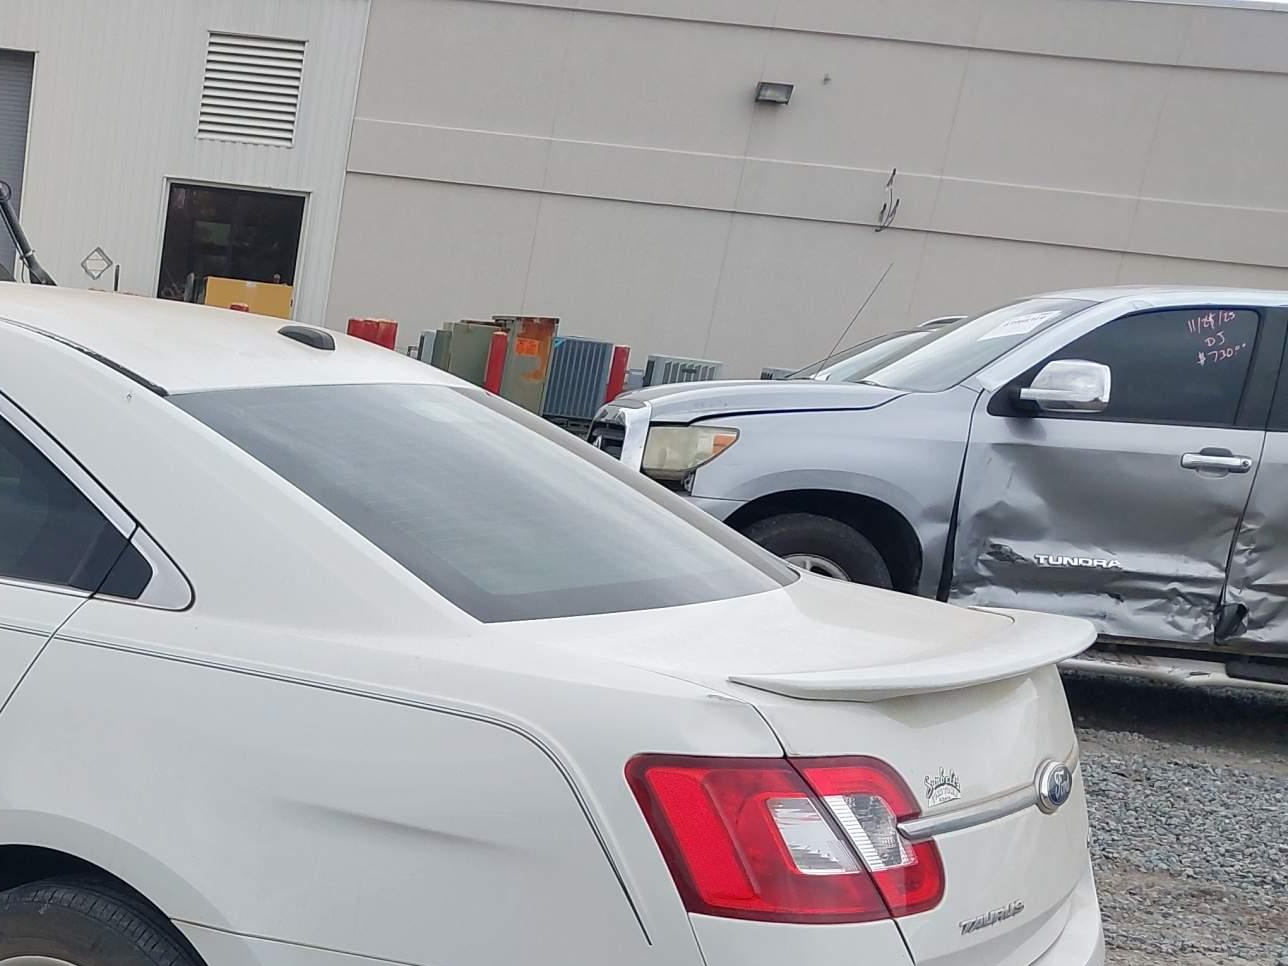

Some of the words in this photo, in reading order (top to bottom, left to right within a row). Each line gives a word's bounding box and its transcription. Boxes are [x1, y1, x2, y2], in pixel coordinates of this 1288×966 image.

[1034, 554, 1121, 569] TUNDRA
[1052, 769, 1070, 801] Ford
[959, 898, 1025, 935] TAURUS
